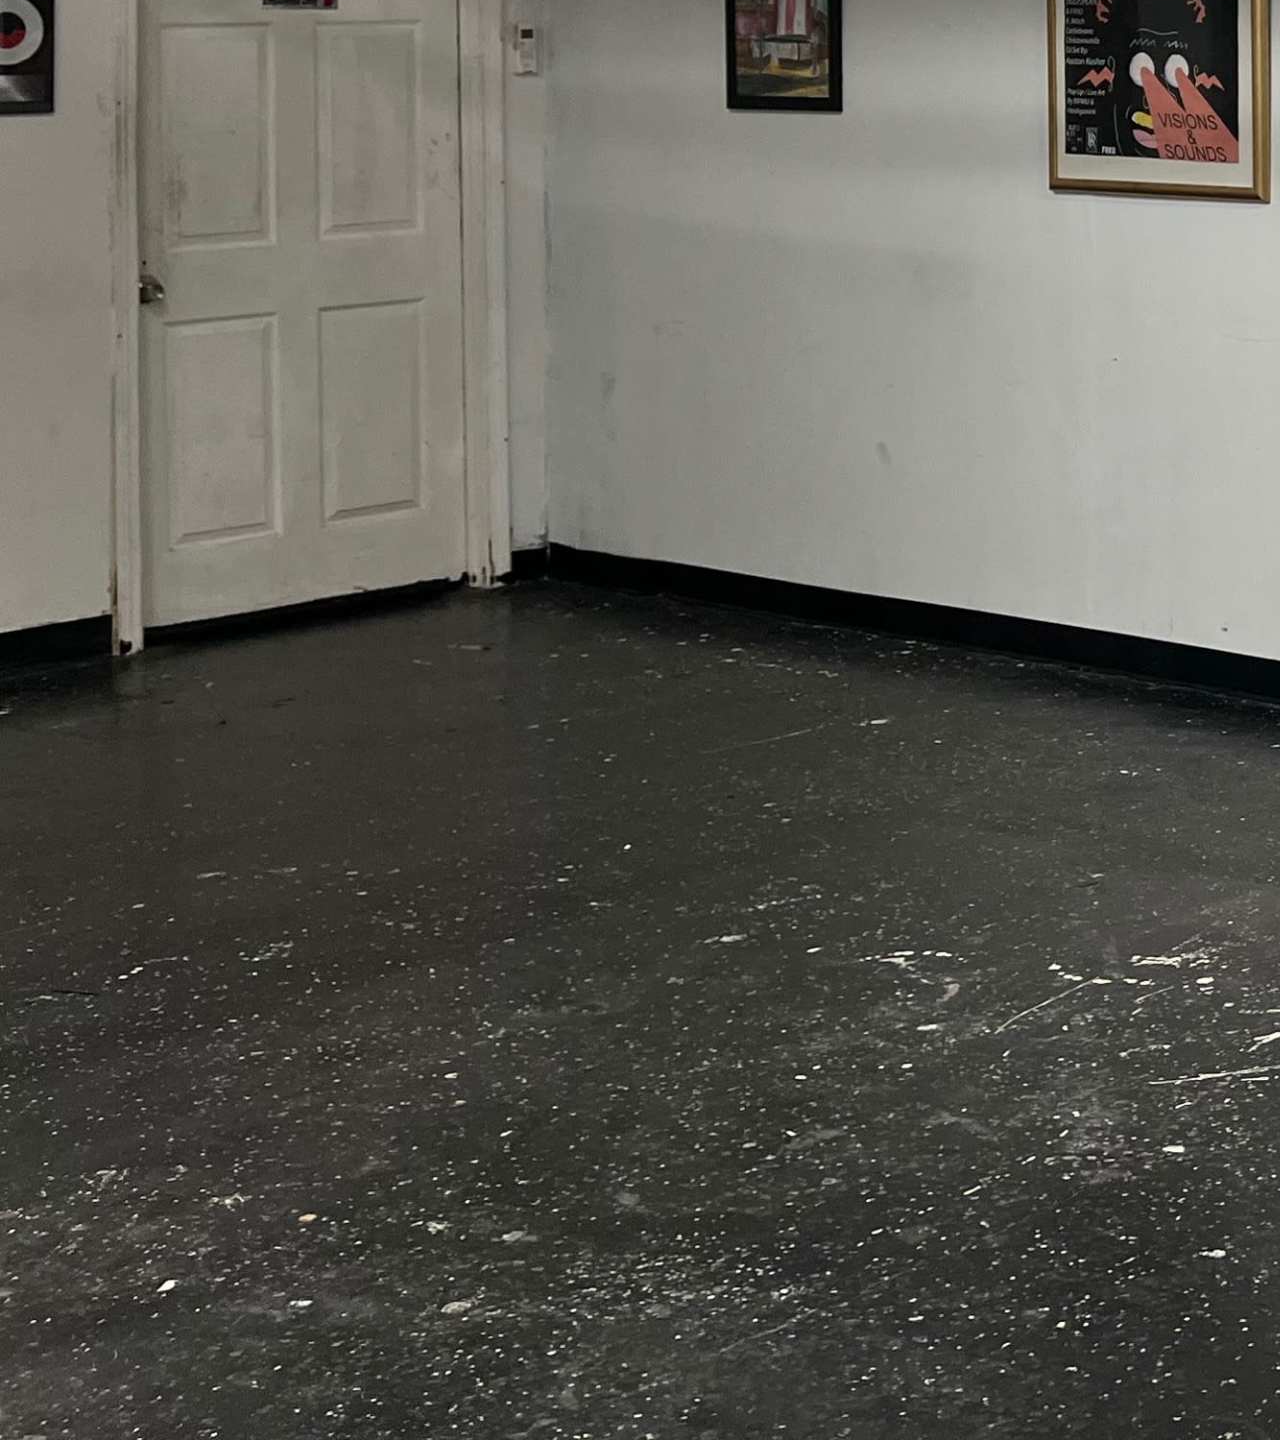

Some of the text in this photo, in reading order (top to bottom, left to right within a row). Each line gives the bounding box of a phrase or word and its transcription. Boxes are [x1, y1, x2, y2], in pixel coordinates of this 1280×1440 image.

[1157, 112, 1218, 130] VISIONS
[1187, 129, 1197, 145] &
[1164, 144, 1227, 162] SOUNDS
